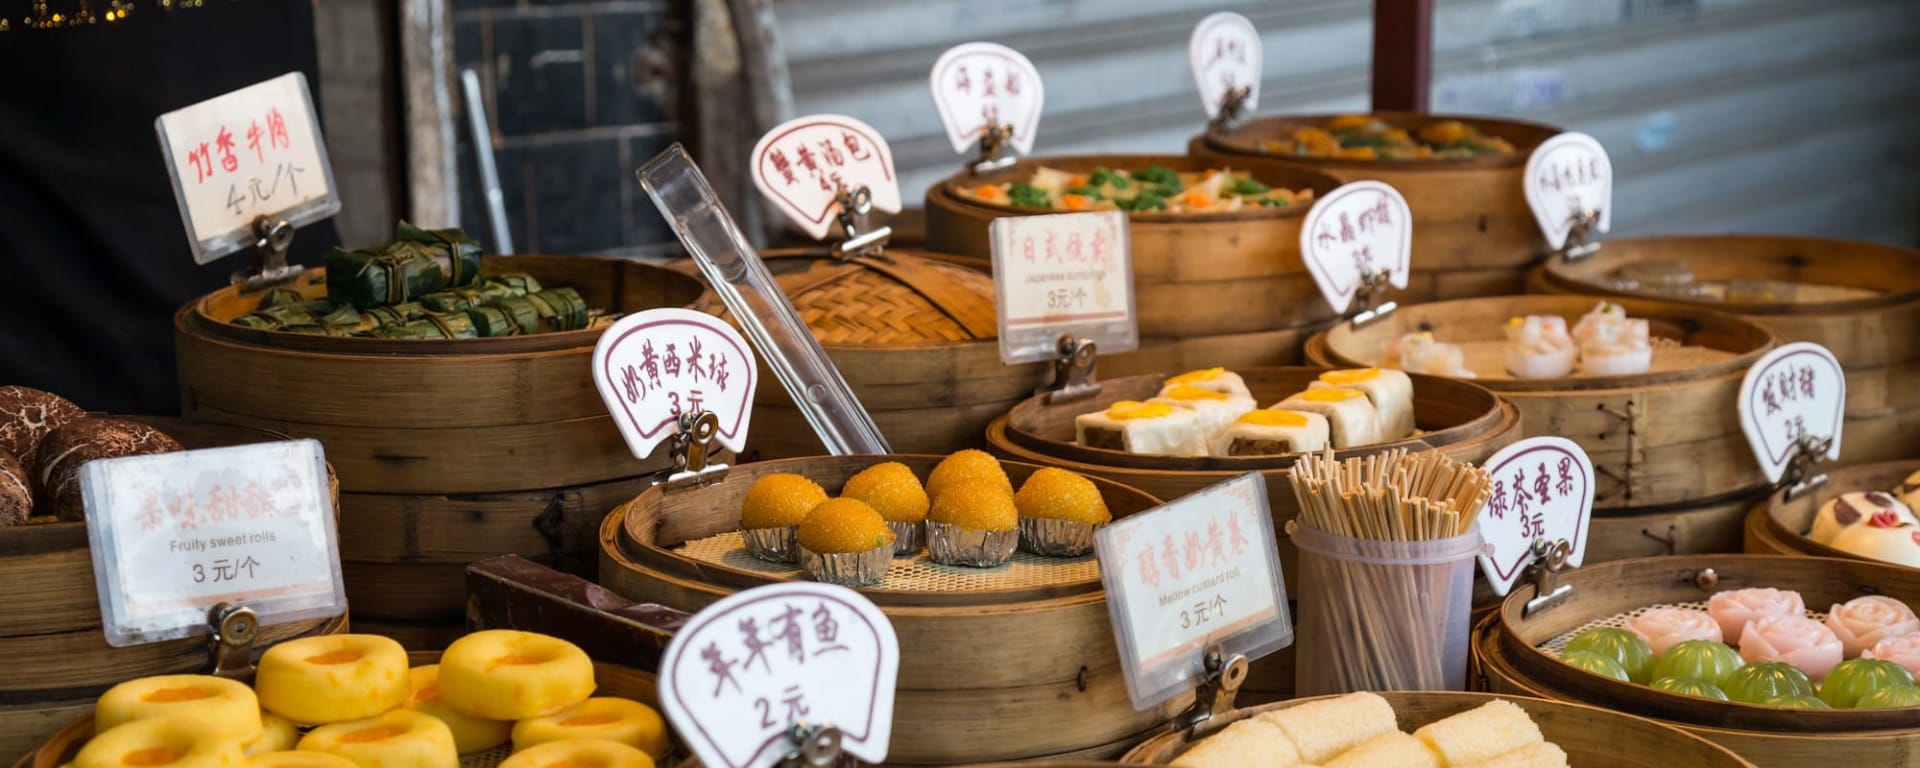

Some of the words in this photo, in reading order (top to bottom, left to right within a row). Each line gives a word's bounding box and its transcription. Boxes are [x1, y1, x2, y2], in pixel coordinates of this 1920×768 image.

[188, 106, 290, 184] 竹香牛肉
[769, 129, 871, 185] 蟹黄汤包
[226, 163, 304, 215] 4元/个
[1048, 288, 1087, 308] 3元/个
[620, 334, 730, 404] 奶黄西米球
[170, 538, 206, 552] Fruity
[209, 535, 247, 548] sweet
[249, 531, 277, 544] rolls
[1520, 512, 1545, 538] 3元
[1159, 588, 1191, 606] Mellow
[1191, 572, 1225, 594] custard
[1225, 565, 1241, 580] roll
[755, 685, 809, 729] 2元
